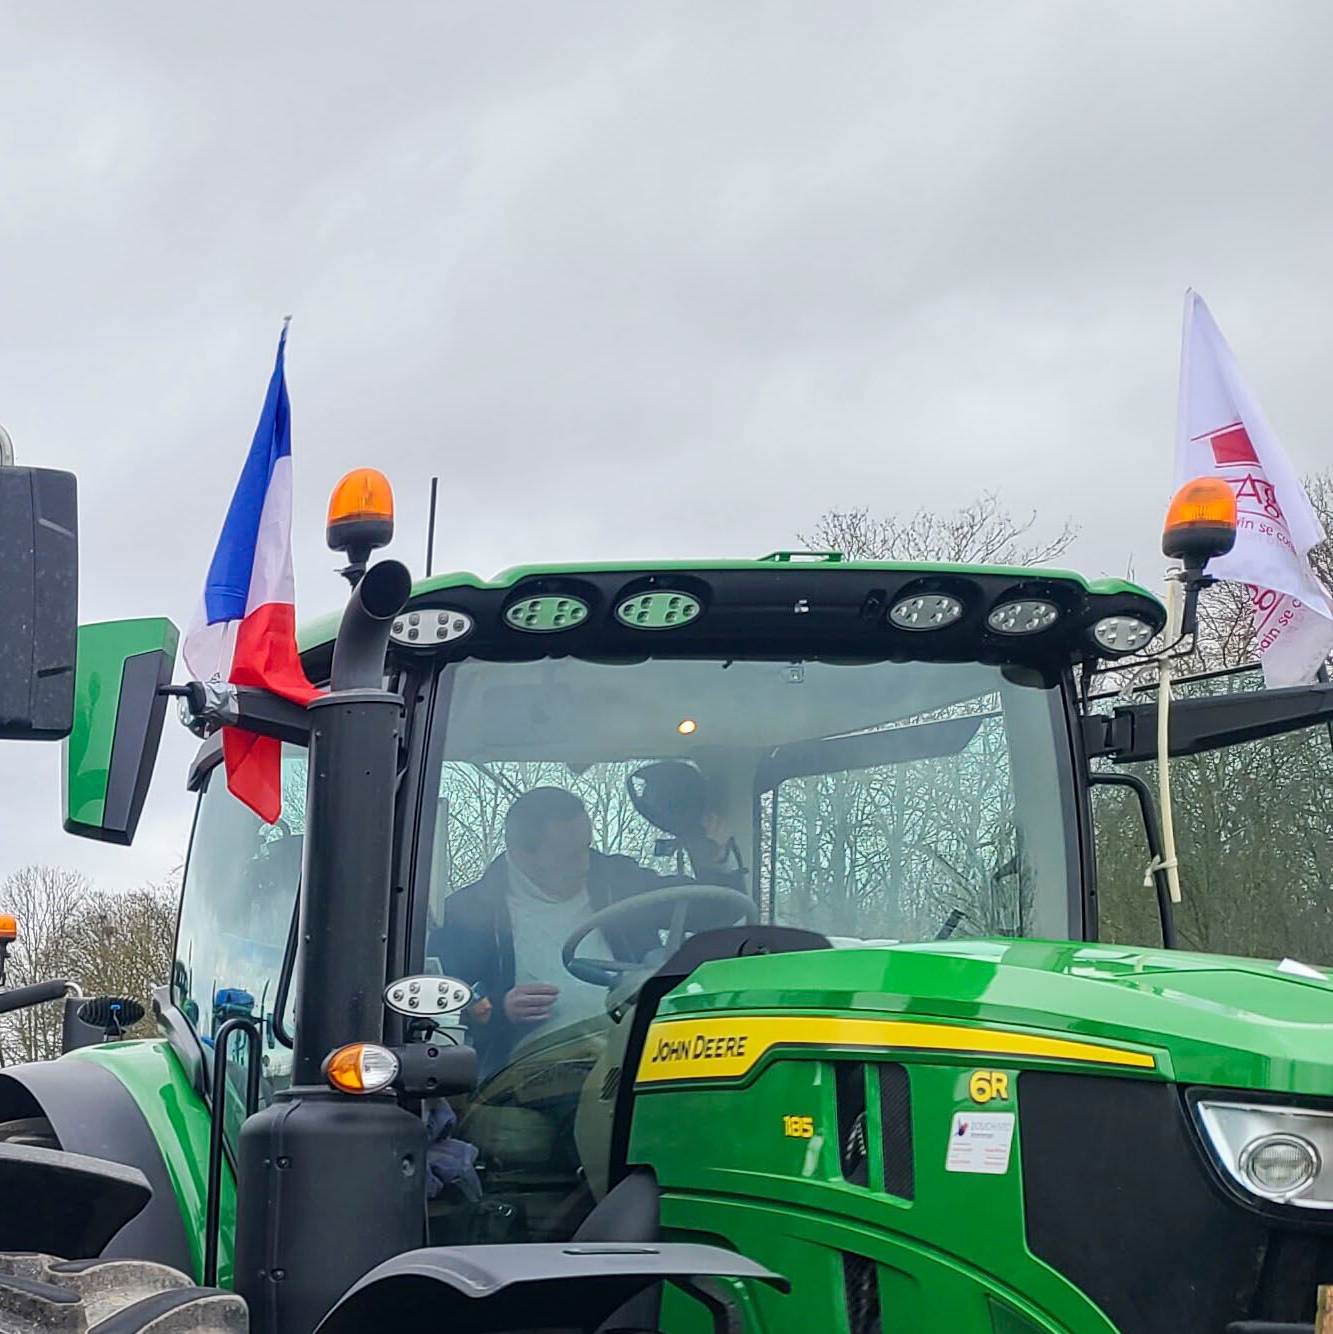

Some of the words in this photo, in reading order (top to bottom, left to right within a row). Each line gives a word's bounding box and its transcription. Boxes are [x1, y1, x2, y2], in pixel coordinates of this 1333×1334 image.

[1259, 522, 1274, 536] se
[1278, 609, 1294, 627] se
[651, 1037, 692, 1063] JOHN
[693, 1035, 748, 1060] DEERE
[970, 1070, 1010, 1103] 6R
